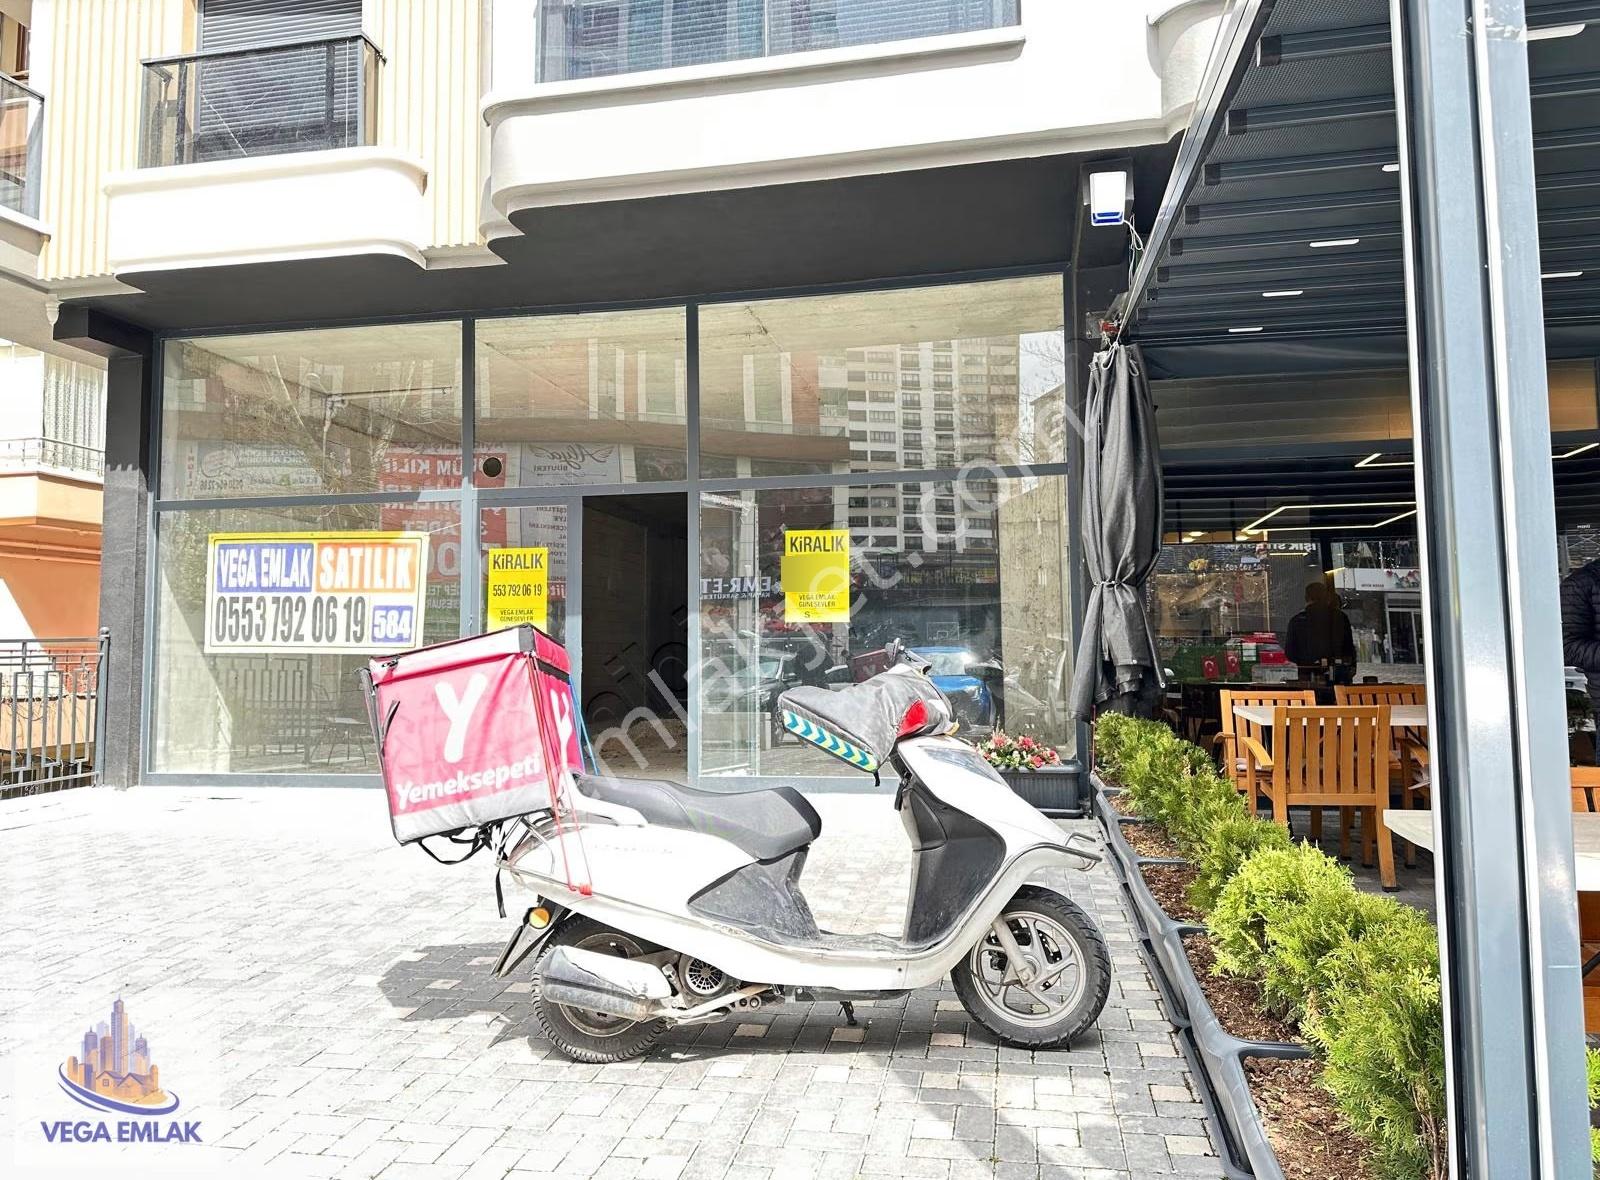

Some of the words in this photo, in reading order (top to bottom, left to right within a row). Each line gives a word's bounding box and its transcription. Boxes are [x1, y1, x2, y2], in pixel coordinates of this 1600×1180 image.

[219, 548, 258, 588] VEGA
[261, 548, 312, 588] EMLAK
[319, 546, 412, 590] SATILIK
[492, 584, 507, 597] 553
[508, 584, 521, 597] 792
[522, 584, 532, 597] 06
[533, 584, 542, 597] 19
[215, 595, 267, 643] 0553
[271, 595, 307, 643] 792
[311, 595, 338, 643] 06
[343, 595, 366, 643] 19
[373, 609, 411, 639] 584
[434, 673, 487, 764] Y
[396, 752, 542, 810] Yemeksepeti
